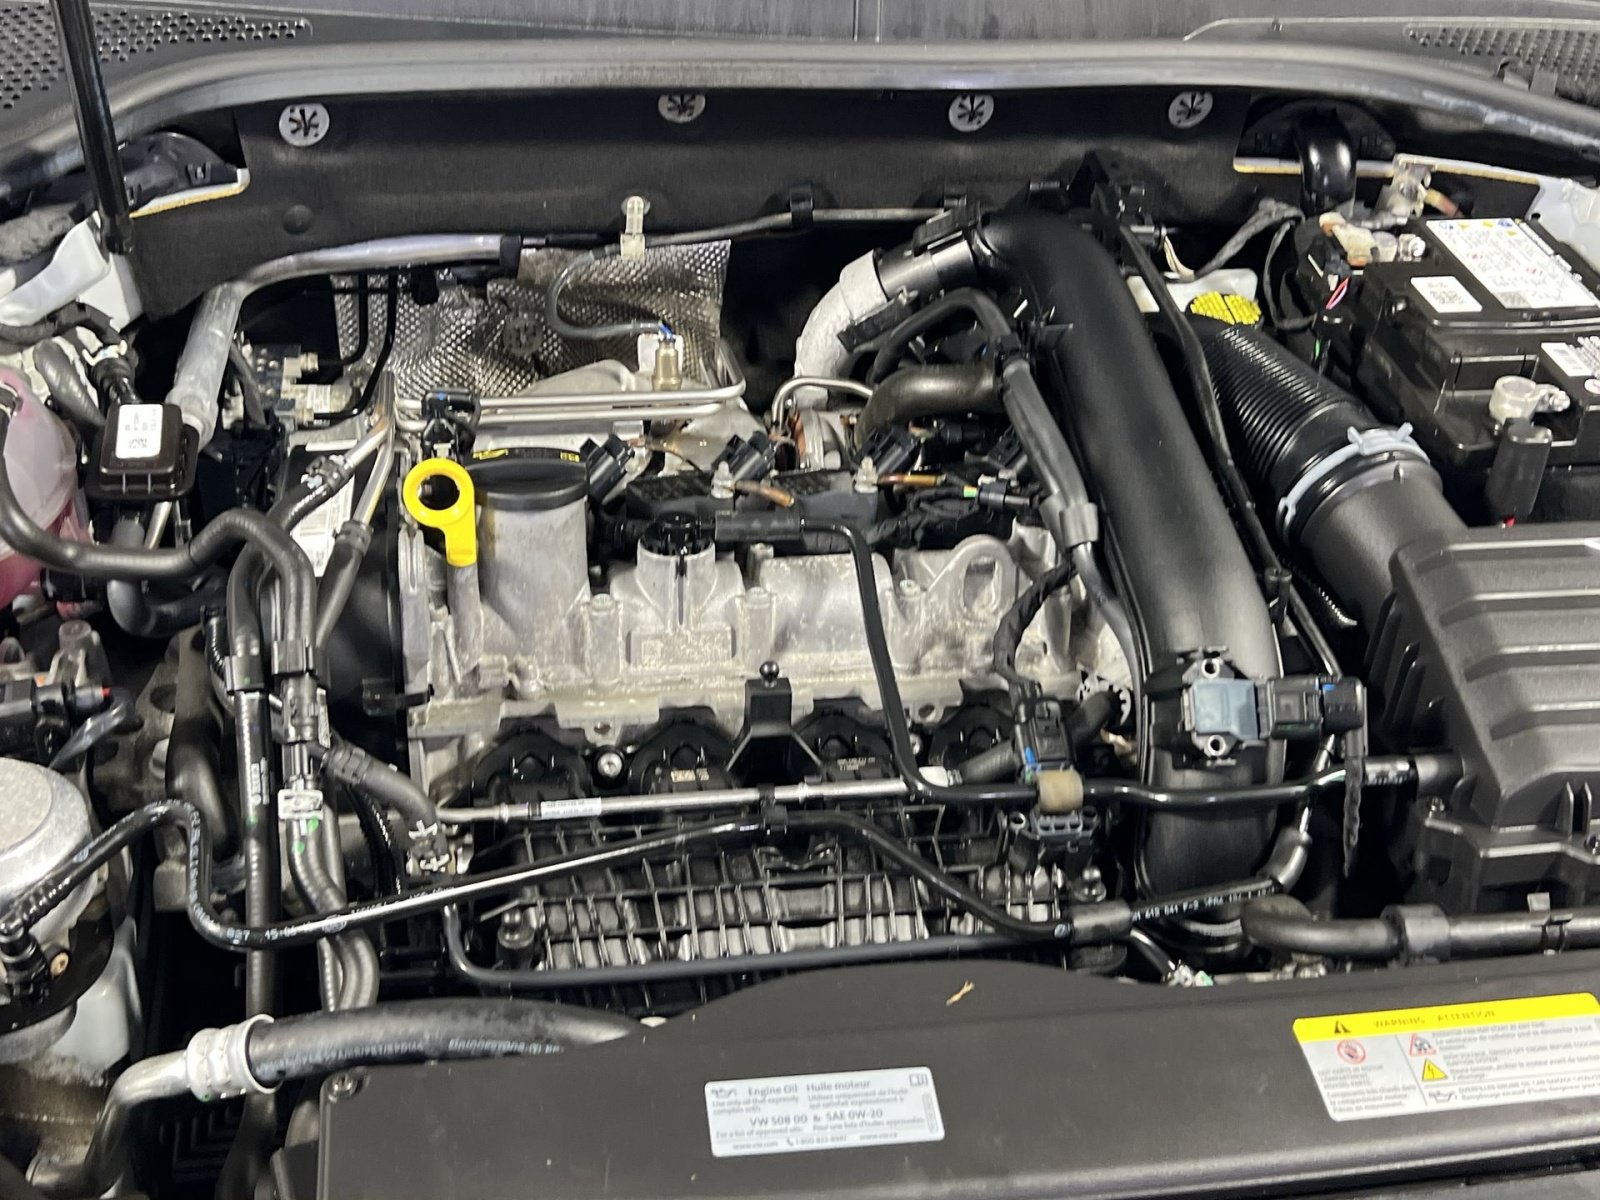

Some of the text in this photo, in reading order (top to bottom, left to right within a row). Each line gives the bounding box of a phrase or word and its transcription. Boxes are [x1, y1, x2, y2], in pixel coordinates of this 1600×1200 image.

[748, 1079, 871, 1097] Engine Oil Huile moteur
[750, 1116, 768, 1126] VW
[771, 1115, 791, 1126] 508
[793, 1114, 808, 1124] 00
[813, 1114, 821, 1123] &
[826, 1111, 846, 1121] SAE
